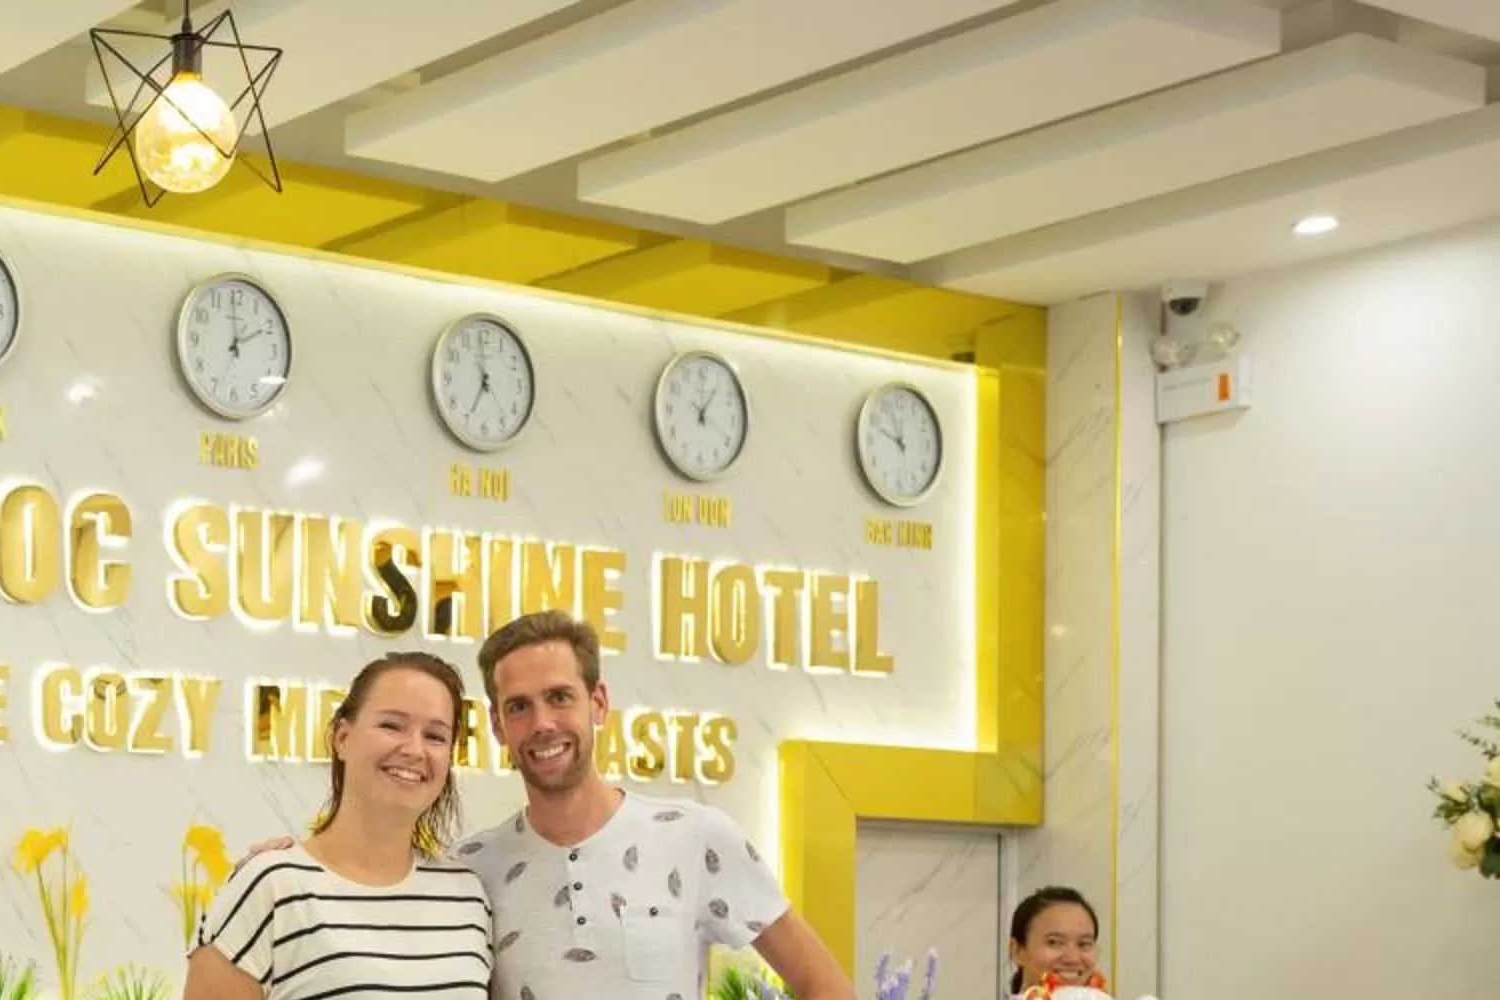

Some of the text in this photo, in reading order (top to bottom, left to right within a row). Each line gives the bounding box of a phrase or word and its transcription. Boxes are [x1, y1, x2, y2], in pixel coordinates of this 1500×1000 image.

[200, 431, 259, 470] PARIS
[169, 503, 628, 653] SUNSHINE
[660, 557, 894, 675] HOTEL
[42, 668, 223, 753] COZY
[595, 709, 737, 784] ASTS
